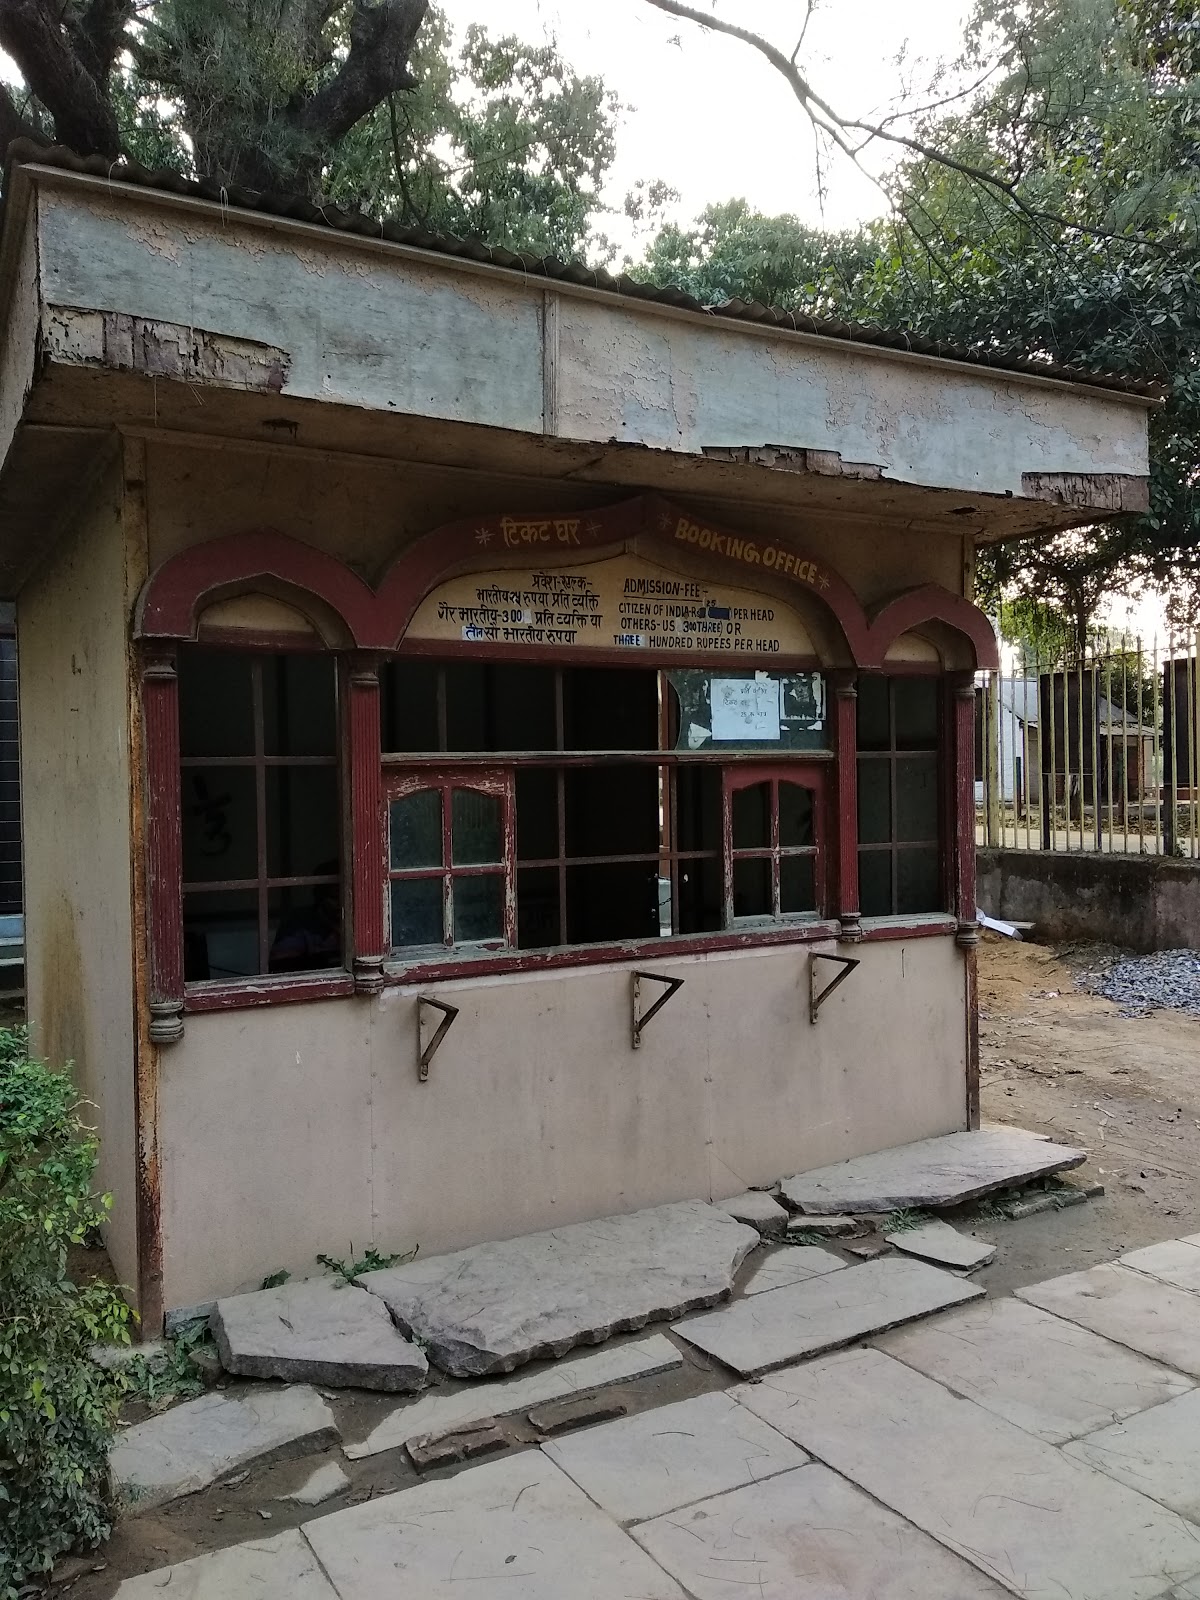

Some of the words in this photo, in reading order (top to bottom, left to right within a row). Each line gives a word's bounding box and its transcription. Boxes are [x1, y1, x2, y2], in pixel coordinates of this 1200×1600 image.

[500, 516, 551, 547] टिकट
[552, 519, 580, 544] घर
[675, 517, 760, 564] BOOKING
[762, 546, 818, 584] OFFICE
[552, 589, 571, 609] प्रति
[572, 589, 600, 611] व्यक्ति
[437, 601, 457, 624] गैर
[534, 609, 555, 629] प्रति
[556, 609, 588, 629] व्यक्ति
[589, 614, 603, 630] या
[618, 602, 651, 616] CITIZEN
[653, 604, 664, 616] OF
[733, 608, 749, 620] PER
[750, 609, 775, 621] HEAD
[502, 625, 545, 645] भारतीय
[726, 622, 742, 636] OR
[613, 634, 641, 647] THREE
[649, 634, 693, 649] HUNDRED
[697, 637, 732, 650] RUPEES
[734, 639, 753, 651] PER
[755, 639, 780, 652] HEAD
